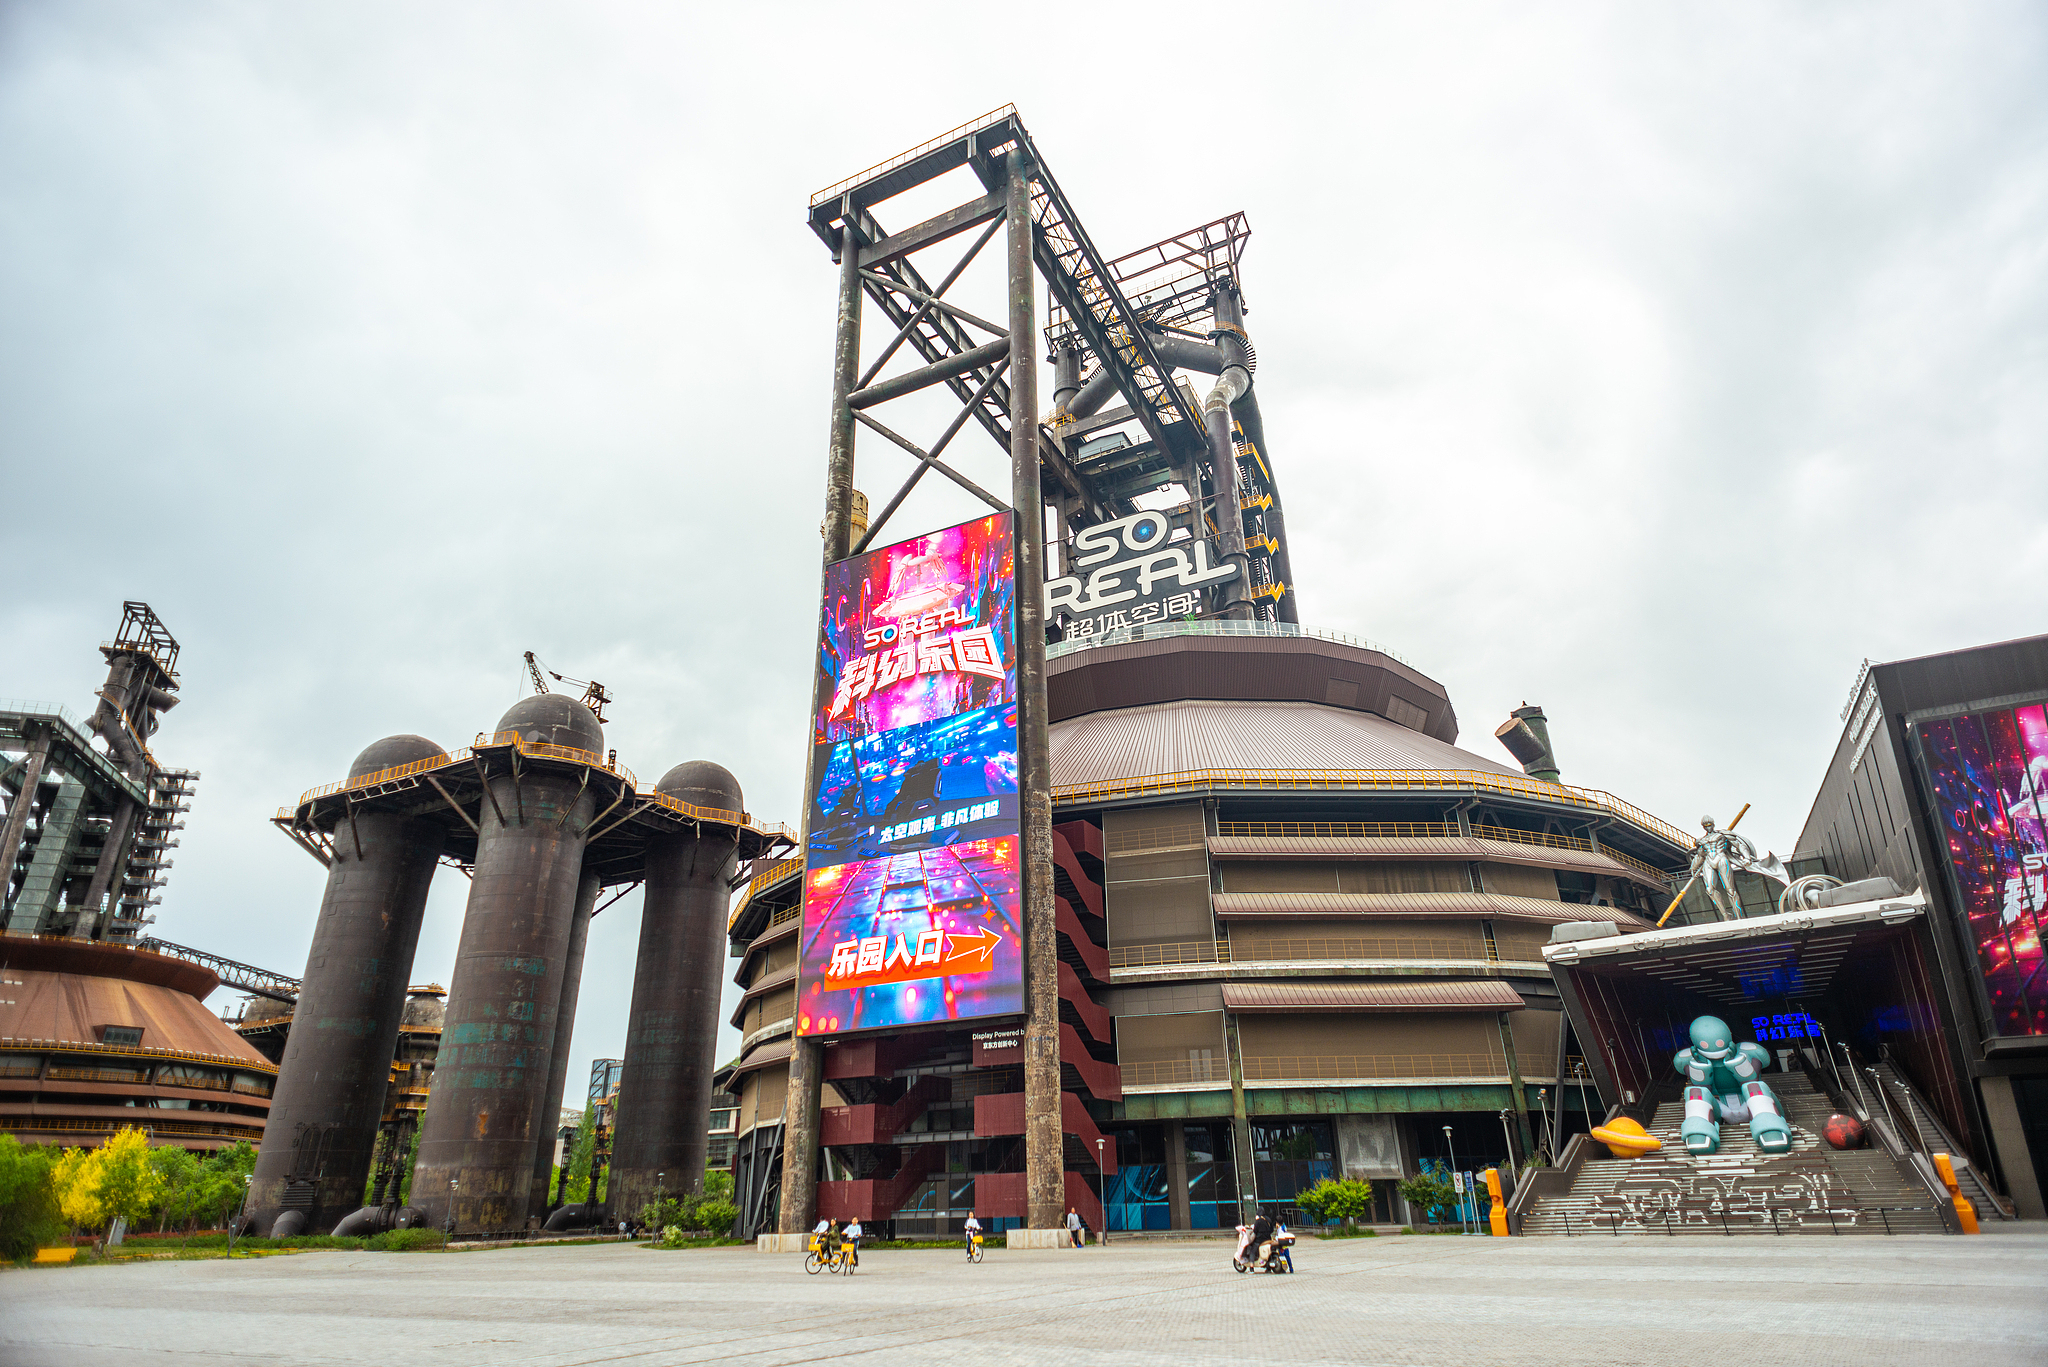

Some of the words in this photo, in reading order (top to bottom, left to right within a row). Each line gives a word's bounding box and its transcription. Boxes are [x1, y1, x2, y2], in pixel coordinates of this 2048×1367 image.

[1076, 511, 1168, 567] SO
[1043, 540, 1236, 621] REAL
[1066, 592, 1199, 643] 超体空间
[828, 623, 1006, 723] 科幻乐园
[879, 815, 936, 845] 太空观光
[940, 799, 999, 828] 非凡体验
[828, 929, 945, 977] 乐园入口
[972, 1032, 993, 1040] Display
[994, 1029, 1019, 1038] Powered
